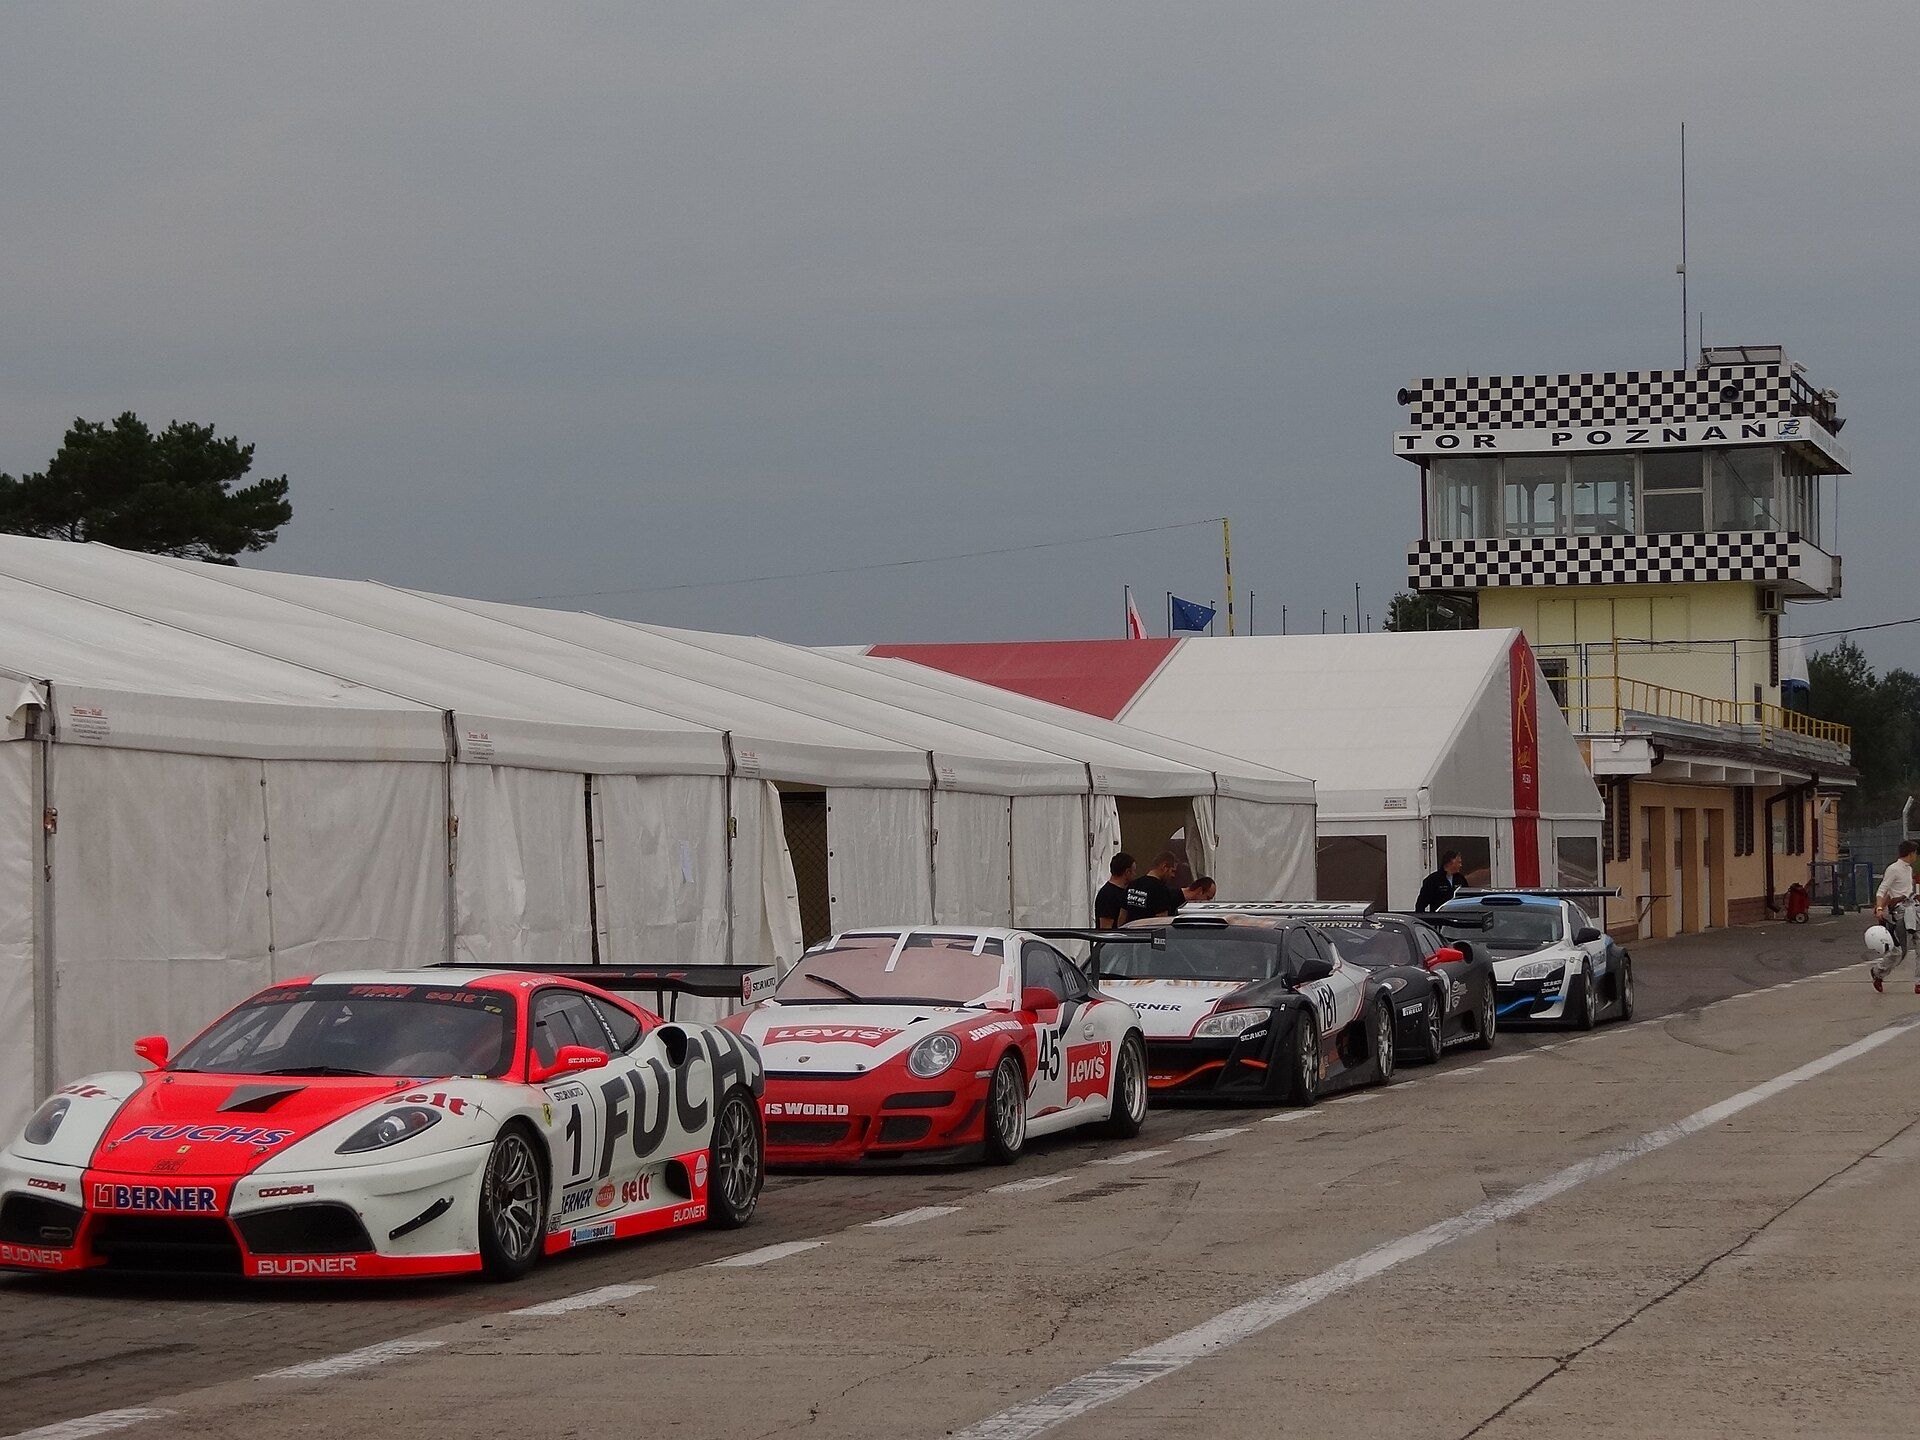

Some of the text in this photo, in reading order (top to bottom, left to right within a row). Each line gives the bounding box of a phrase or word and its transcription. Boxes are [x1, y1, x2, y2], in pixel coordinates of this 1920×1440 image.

[1399, 419, 1767, 450] TOR POZNAŃ
[1128, 1002, 1182, 1012] ERNER
[1402, 1002, 1423, 1017] PIRELLI
[1037, 1028, 1061, 1082] 45
[784, 1102, 850, 1116] WORLD
[120, 1124, 296, 1147] FUCHS
[565, 1102, 582, 1177] 1
[114, 1184, 219, 1213] BERNER
[621, 1172, 651, 1204] selt
[673, 1204, 706, 1223] BUDNER
[1, 1245, 64, 1265] BUDNER
[257, 1257, 357, 1275] BUDNER
